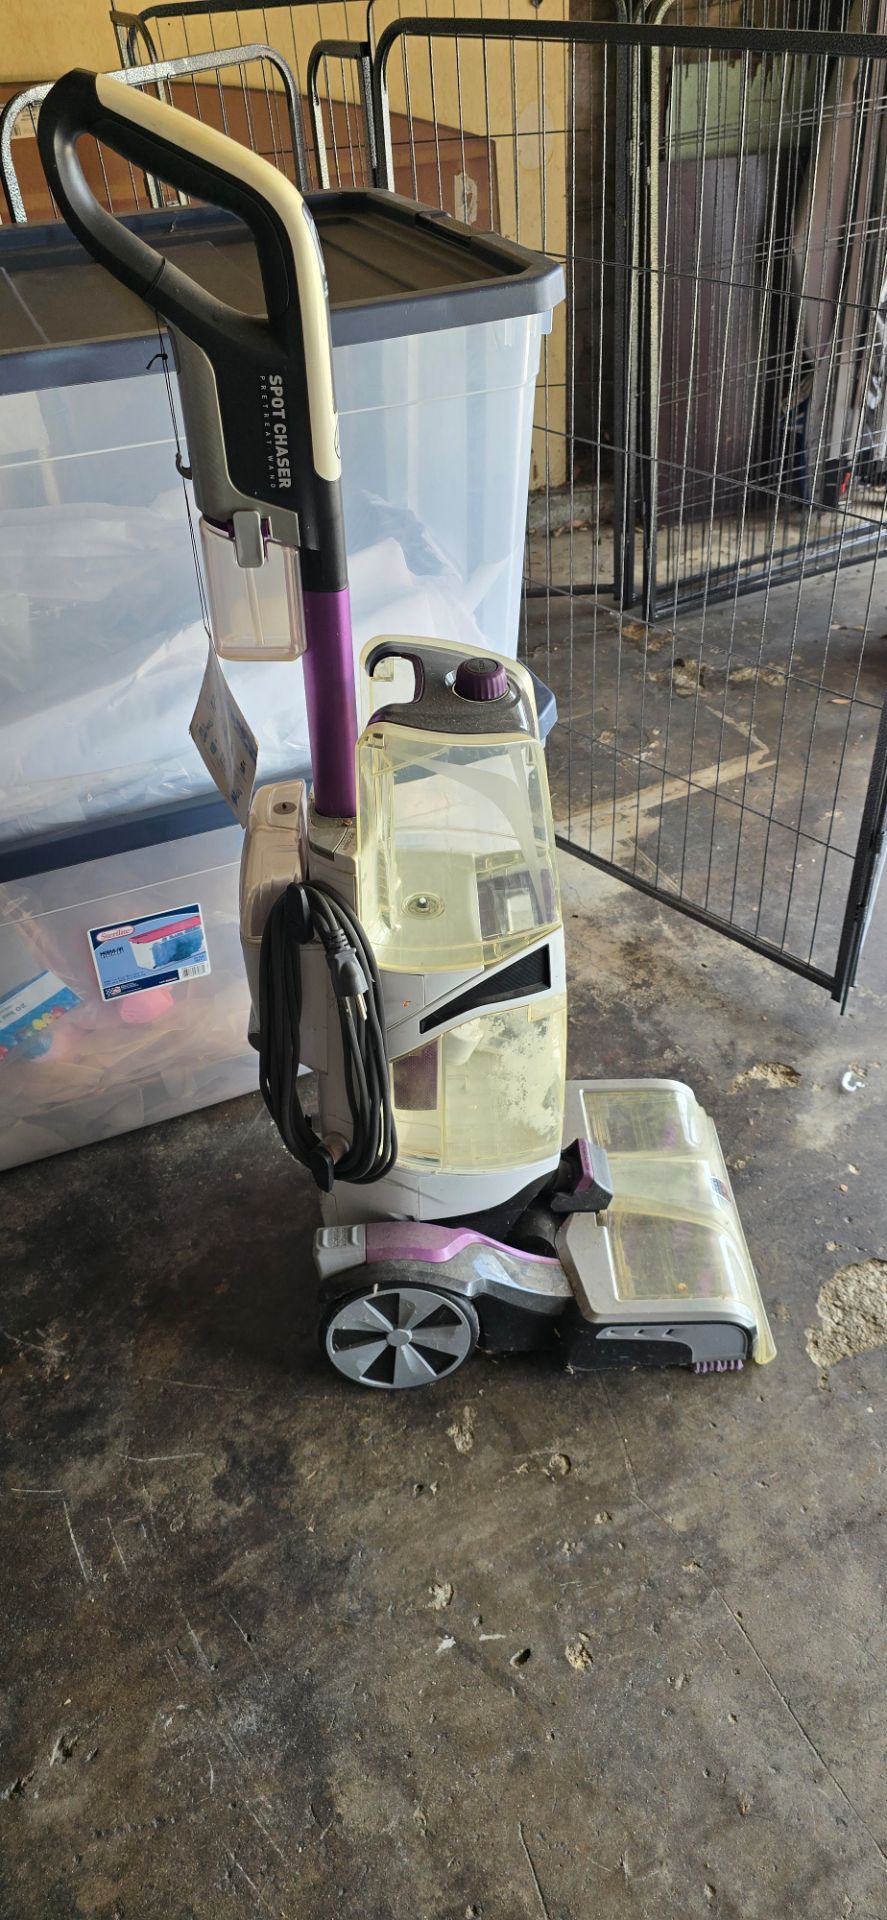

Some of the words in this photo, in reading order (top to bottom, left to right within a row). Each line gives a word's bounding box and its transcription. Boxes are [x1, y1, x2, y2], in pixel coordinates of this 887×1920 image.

[269, 375, 286, 419] SPOT
[260, 376, 272, 444] PRETREAT
[267, 456, 276, 488] WAND
[273, 424, 291, 488] CHASER
